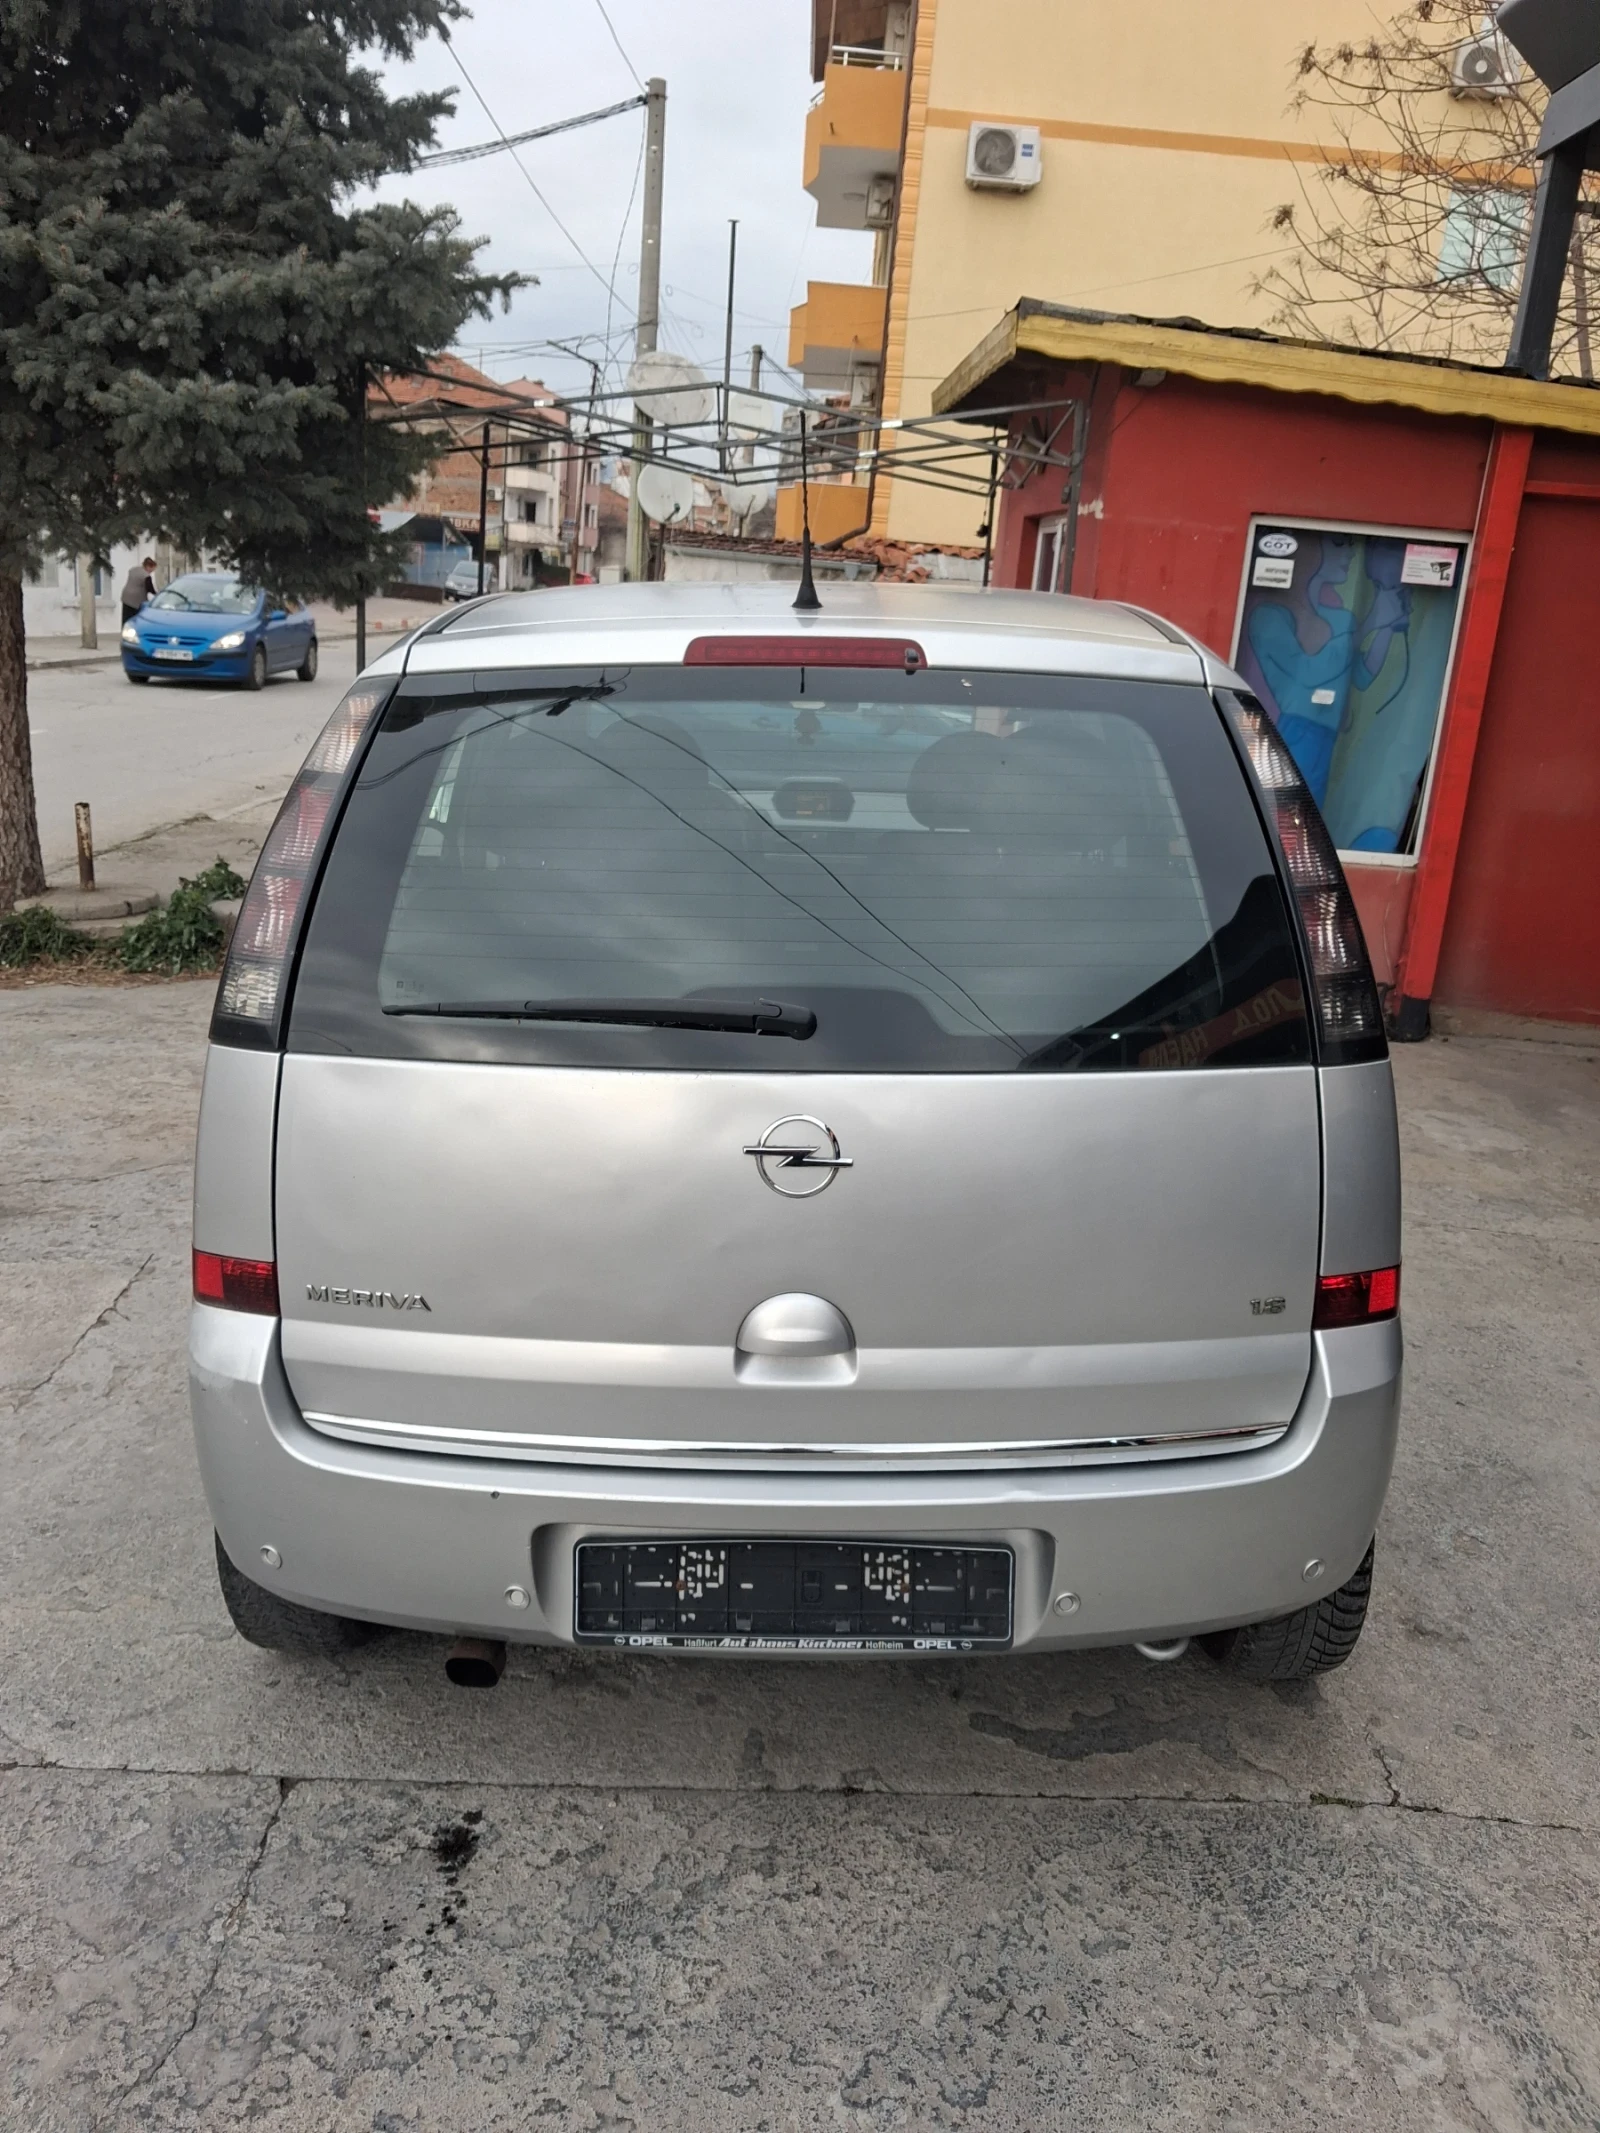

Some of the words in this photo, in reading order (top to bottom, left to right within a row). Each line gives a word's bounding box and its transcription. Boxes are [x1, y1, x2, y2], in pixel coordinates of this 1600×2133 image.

[306, 1284, 432, 1312] MERIVA
[629, 1636, 673, 1646] OPEL
[798, 1639, 863, 1650] Kirchner
[865, 1640, 904, 1650] Hofheim
[913, 1639, 957, 1650] OPEL
